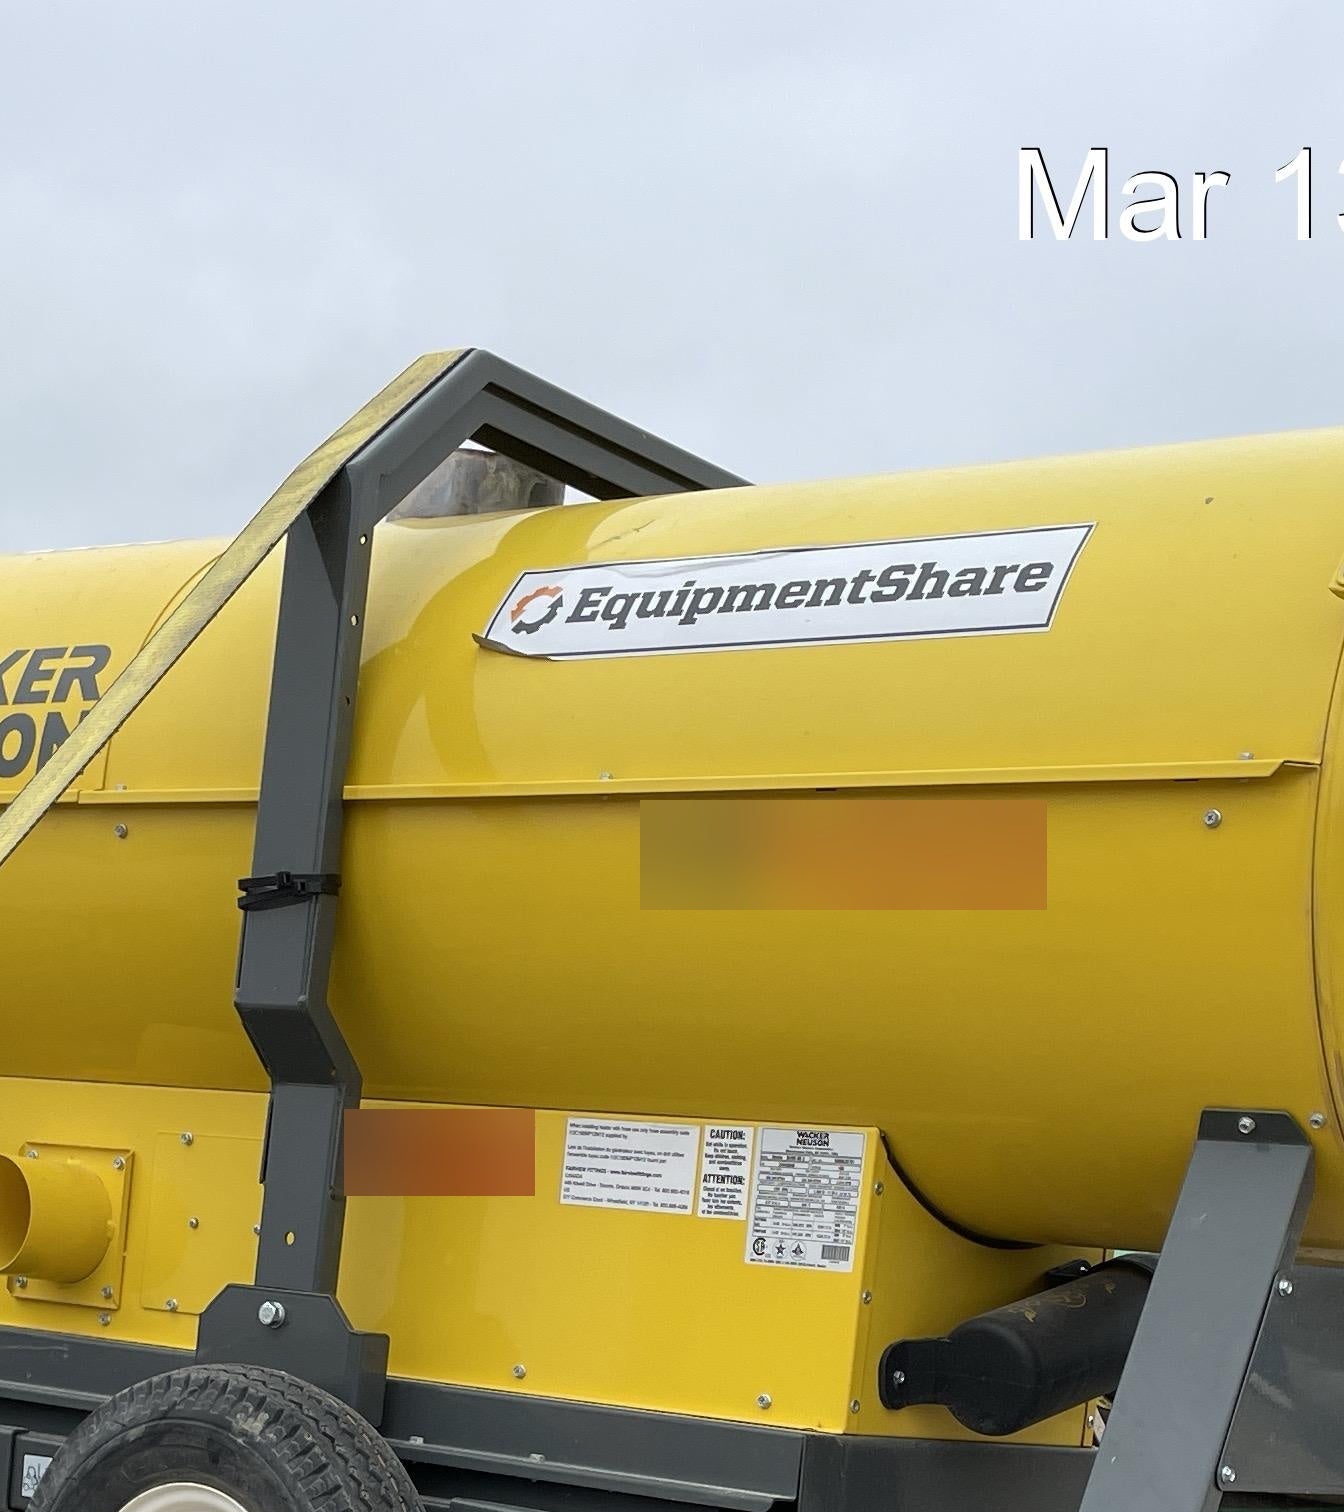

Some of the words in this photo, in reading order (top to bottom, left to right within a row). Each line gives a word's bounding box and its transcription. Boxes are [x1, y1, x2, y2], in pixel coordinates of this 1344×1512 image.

[564, 558, 1055, 630] EquipmentShare
[709, 1128, 746, 1140] CAUTION:
[796, 1130, 830, 1140] WACKER
[796, 1138, 830, 1147] NEUSON
[702, 1173, 746, 1185] ATTENTION:
